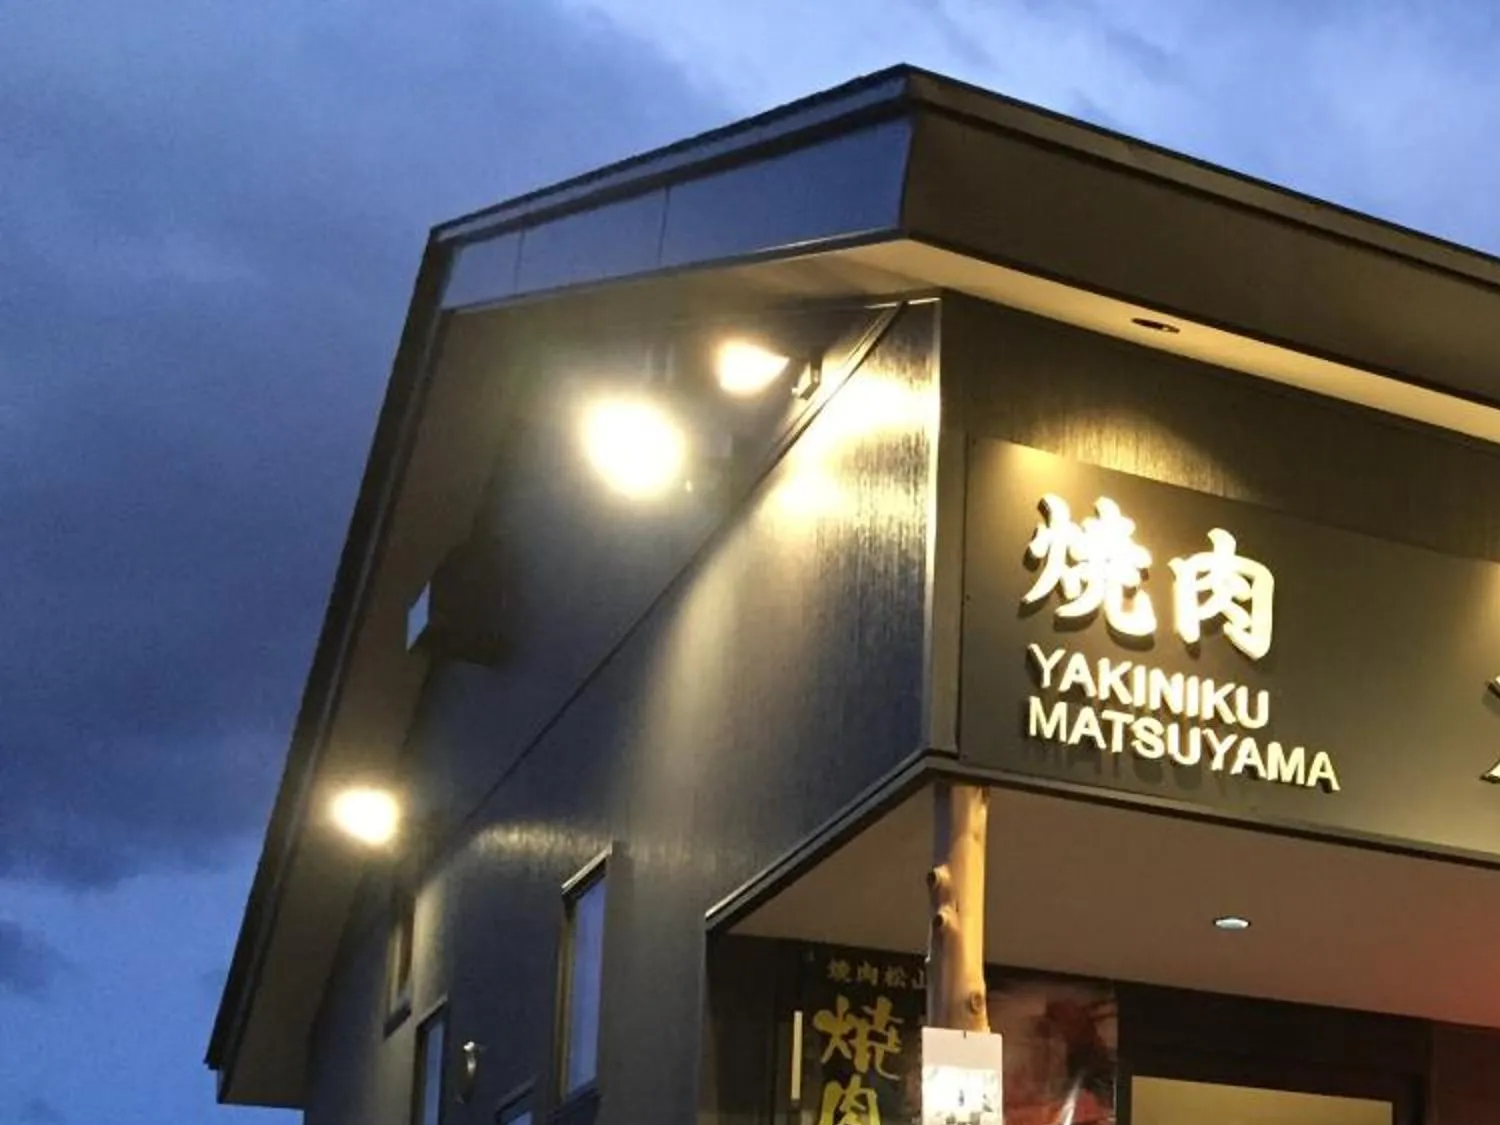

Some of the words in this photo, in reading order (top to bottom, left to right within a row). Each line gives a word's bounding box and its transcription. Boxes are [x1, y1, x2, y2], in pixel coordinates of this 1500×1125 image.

[1020, 494, 1276, 660] 焼肉
[1027, 643, 1270, 728] YAKINIKU
[1027, 696, 1342, 791] MATSUYAMA
